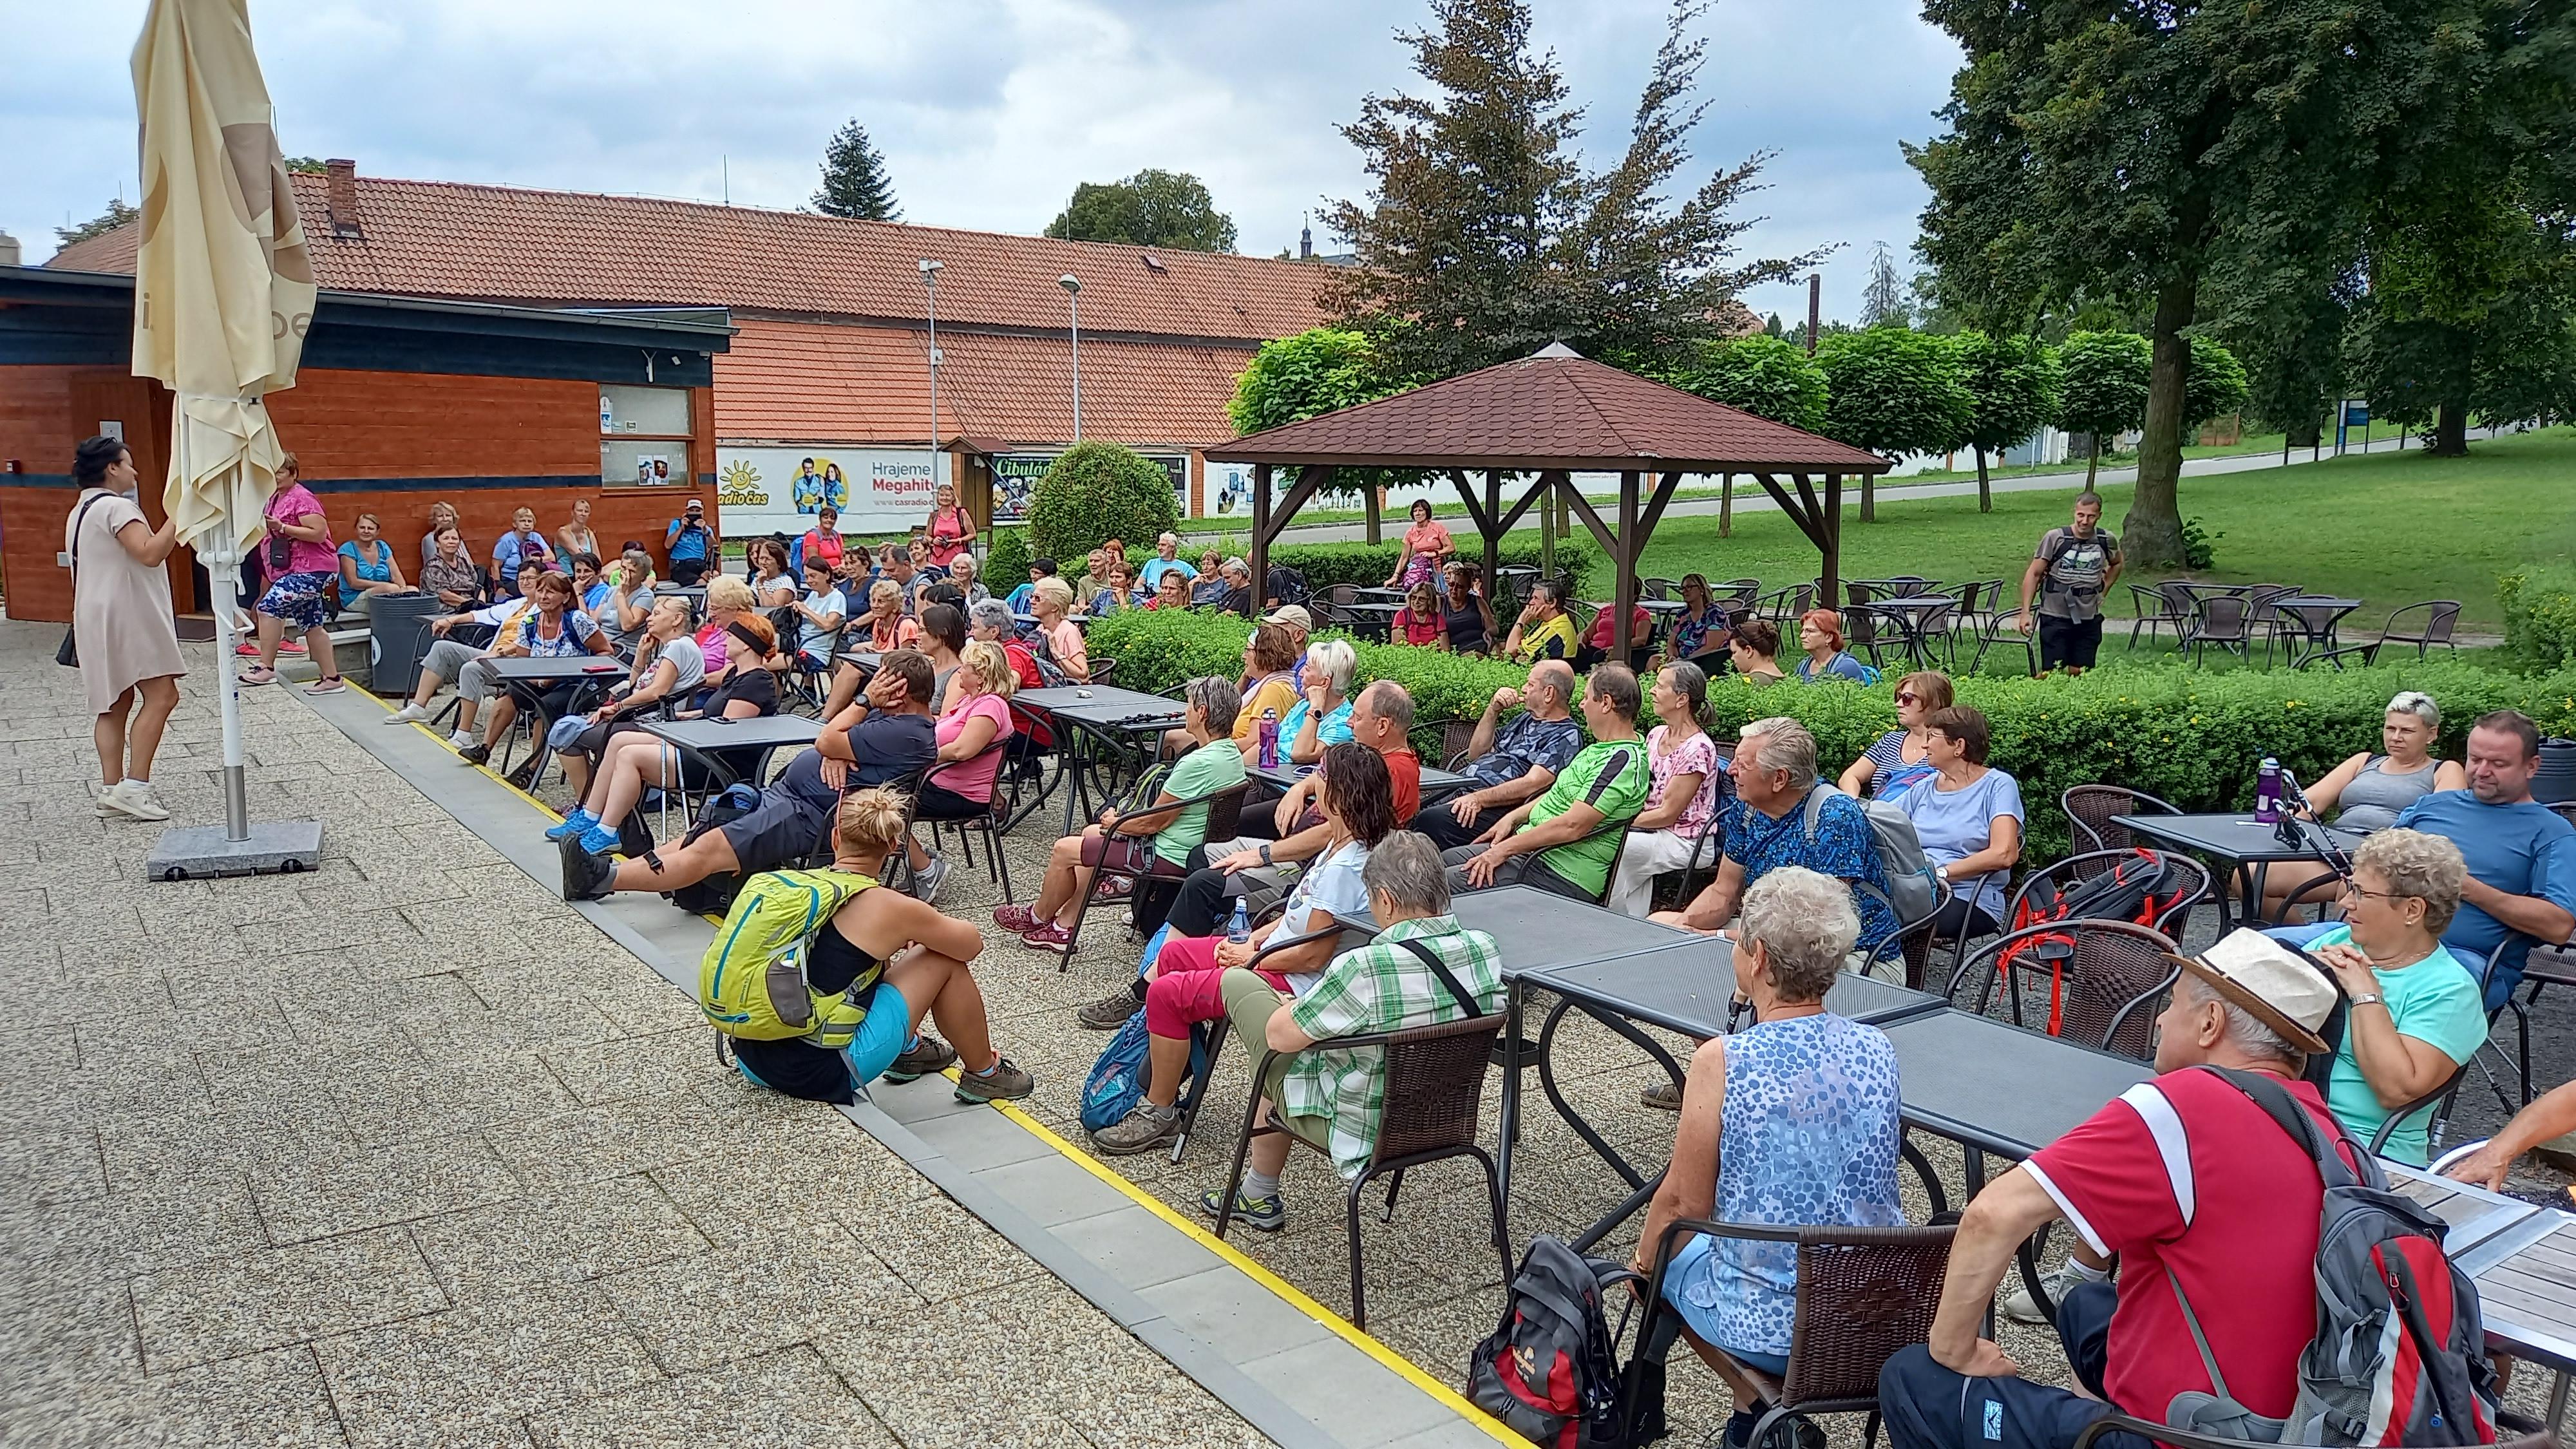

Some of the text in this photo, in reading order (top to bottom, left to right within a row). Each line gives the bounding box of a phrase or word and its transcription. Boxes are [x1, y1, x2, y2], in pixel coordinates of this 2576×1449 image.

[872, 462, 931, 478] Hrajeme
[717, 490, 769, 506] adio čas
